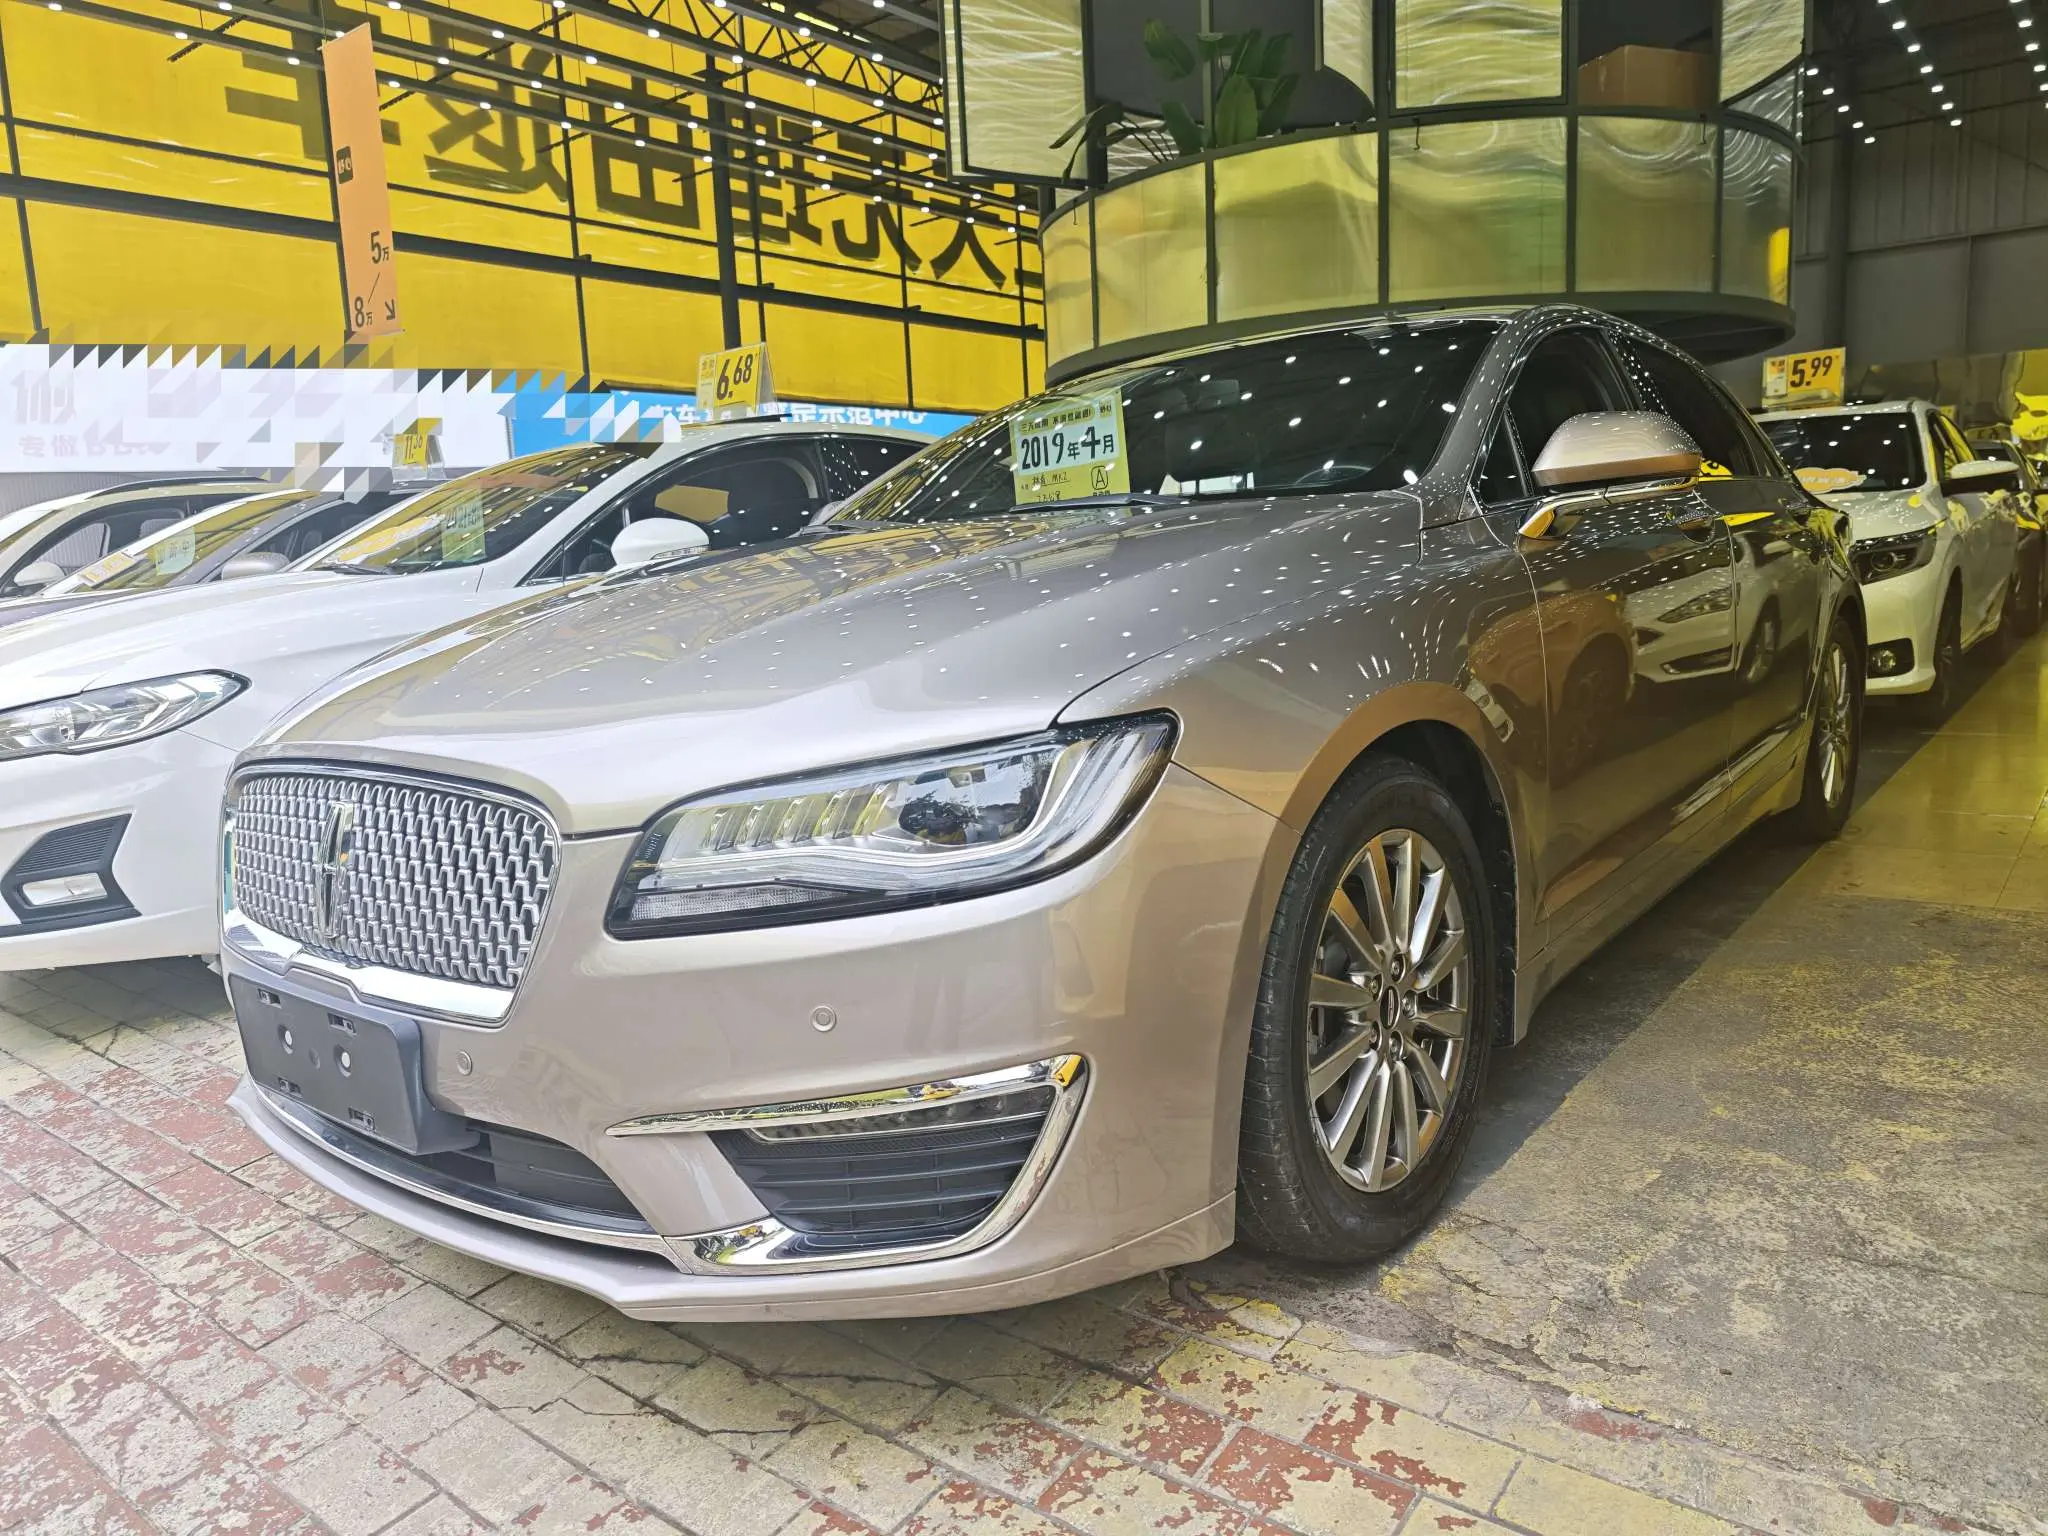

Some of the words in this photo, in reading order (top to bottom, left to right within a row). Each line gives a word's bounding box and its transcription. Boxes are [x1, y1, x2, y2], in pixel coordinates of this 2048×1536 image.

[370, 230, 389, 264] 5万
[354, 296, 373, 327] 8万
[717, 353, 754, 400] 6.68
[1790, 355, 1833, 387] 5.99
[1021, 425, 1114, 469] 2019年4月
[1095, 469, 1107, 489] A
